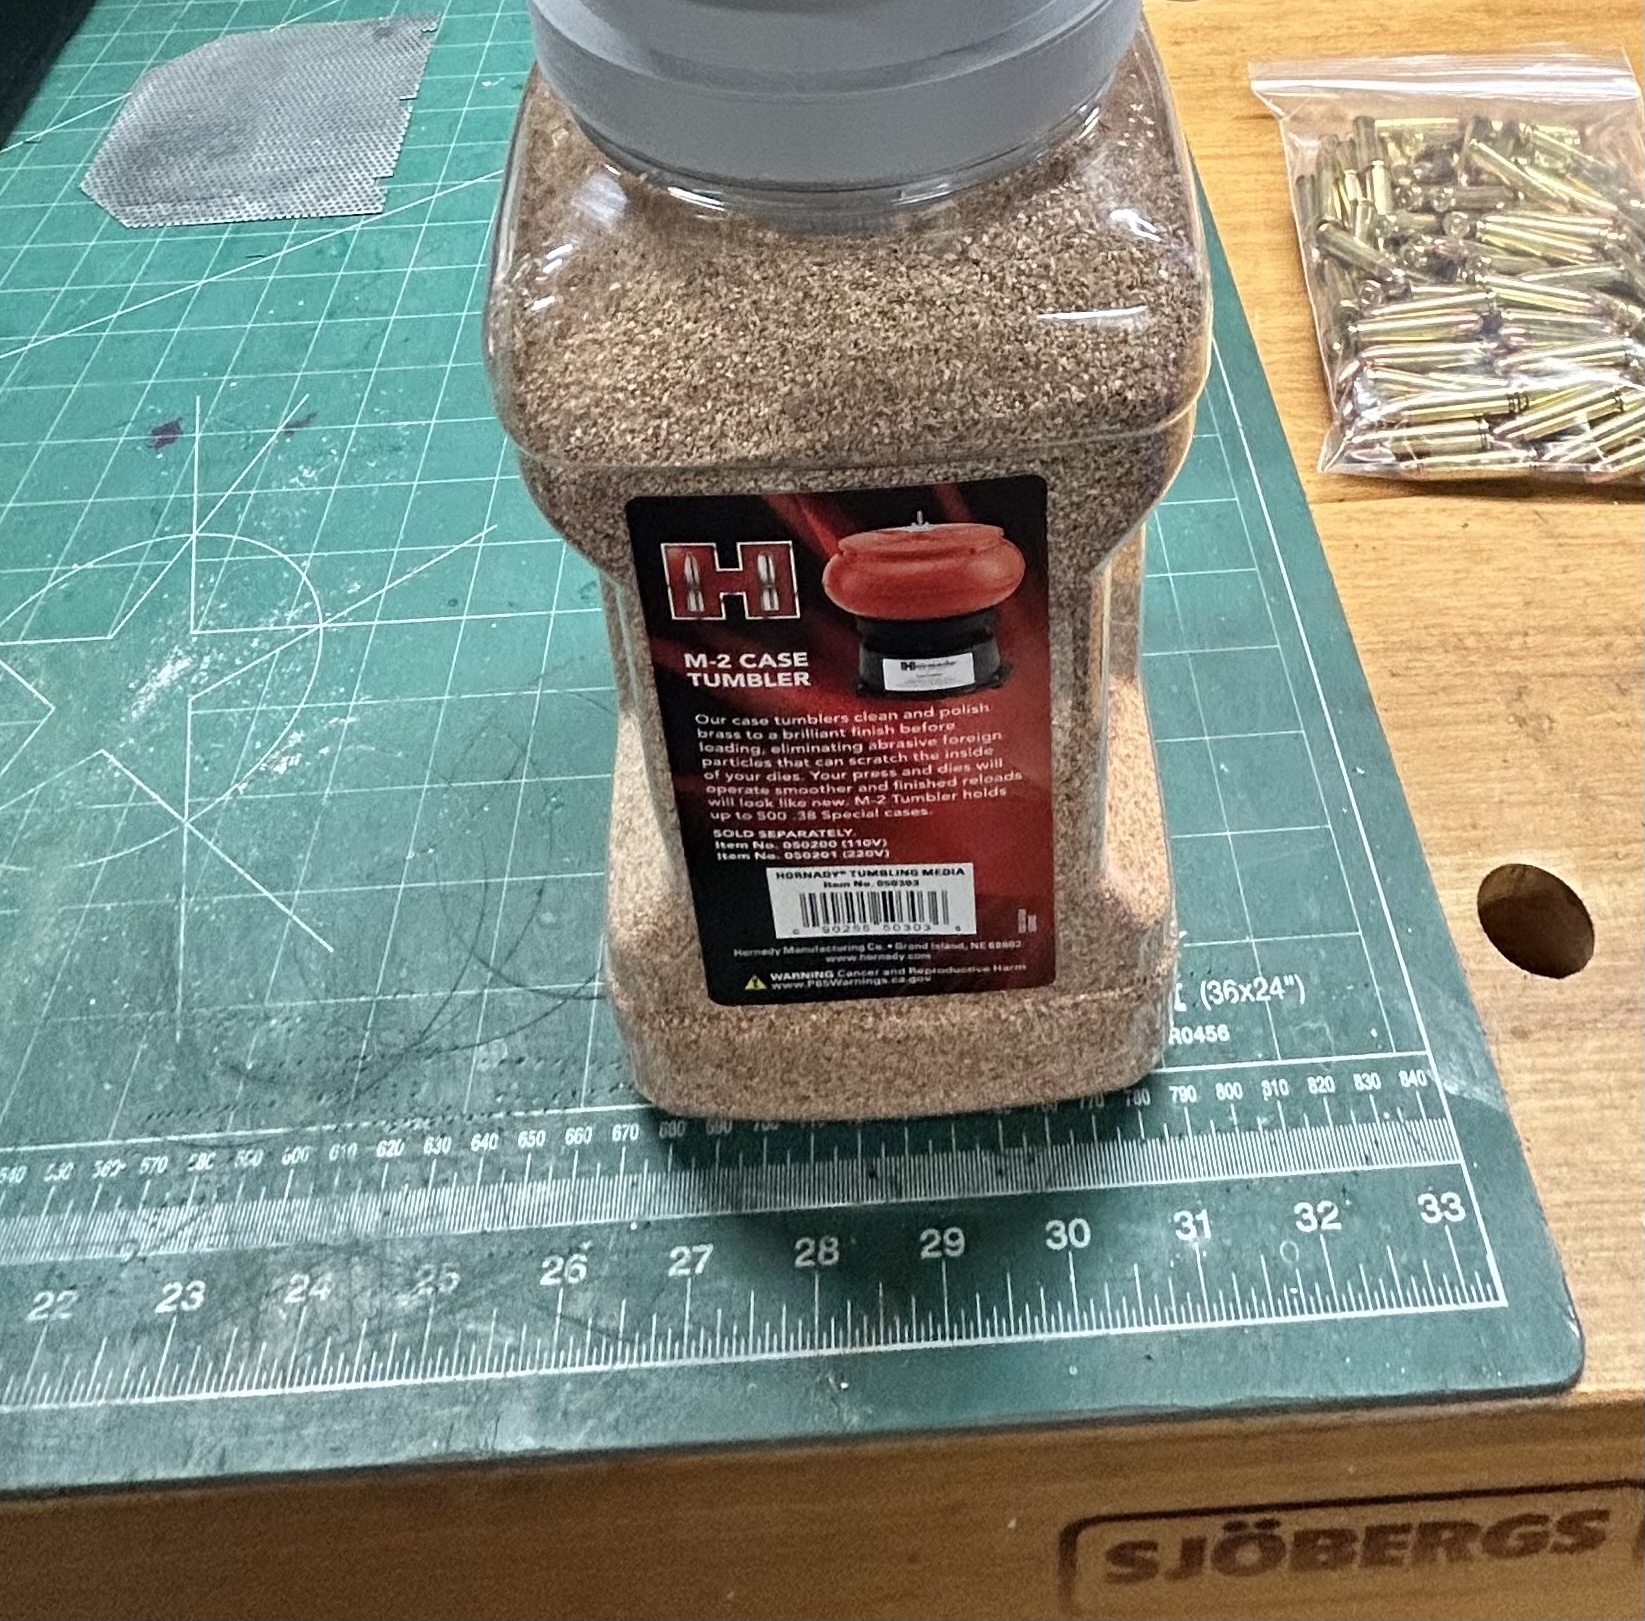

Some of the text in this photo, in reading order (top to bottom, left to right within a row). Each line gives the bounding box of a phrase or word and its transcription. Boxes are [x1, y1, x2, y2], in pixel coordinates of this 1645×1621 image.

[685, 652, 809, 668] M-2 CASE
[687, 672, 811, 688] TUMBLER
[695, 703, 990, 726] Our case tumblers clean and polish
[697, 722, 956, 740] brass to a brilliant finish before
[699, 732, 1003, 756] loading, eliminating abrasive foreign
[702, 746, 994, 768] particles that can scratch the inside
[704, 758, 1003, 783] of your dies. Your press and dies will
[706, 770, 1023, 796] operate smoother and finished reloads
[708, 797, 734, 807] will
[739, 797, 774, 808] look
[779, 798, 807, 808] like
[854, 794, 887, 806] M-2
[892, 791, 958, 804] Tumbler
[963, 786, 1007, 800] holds
[710, 808, 933, 822] up to 500 .38 Special cases.
[713, 828, 856, 839] SOLD SEPARATELY.
[715, 838, 888, 850] Item No. 050200 (110V)
[717, 848, 889, 861] Item No. 050201 (220V)
[850, 868, 918, 878] TUMBLING
[922, 867, 965, 876] MEDIA
[783, 943, 866, 955] Manufacturing
[970, 941, 986, 950] NE
[883, 967, 905, 975] and
[1200, 974, 1305, 1011] (36x24")
[140, 1156, 168, 1174] 570
[376, 1138, 405, 1158] 620
[423, 1135, 452, 1154] 630
[470, 1132, 499, 1151] 640
[517, 1129, 546, 1148] 650
[564, 1126, 593, 1146] 660
[611, 1123, 640, 1142] 670
[1169, 1085, 1197, 1104] 790
[1215, 1082, 1243, 1100] 800
[1307, 1075, 1335, 1094] 820
[1353, 1072, 1382, 1091] 830
[1399, 1069, 1428, 1087] 840
[26, 1191, 1466, 1321] 22 23 24 25 26 27 28 29 30 31 32 33
[1106, 1509, 1610, 1584] SJÖBERGS
